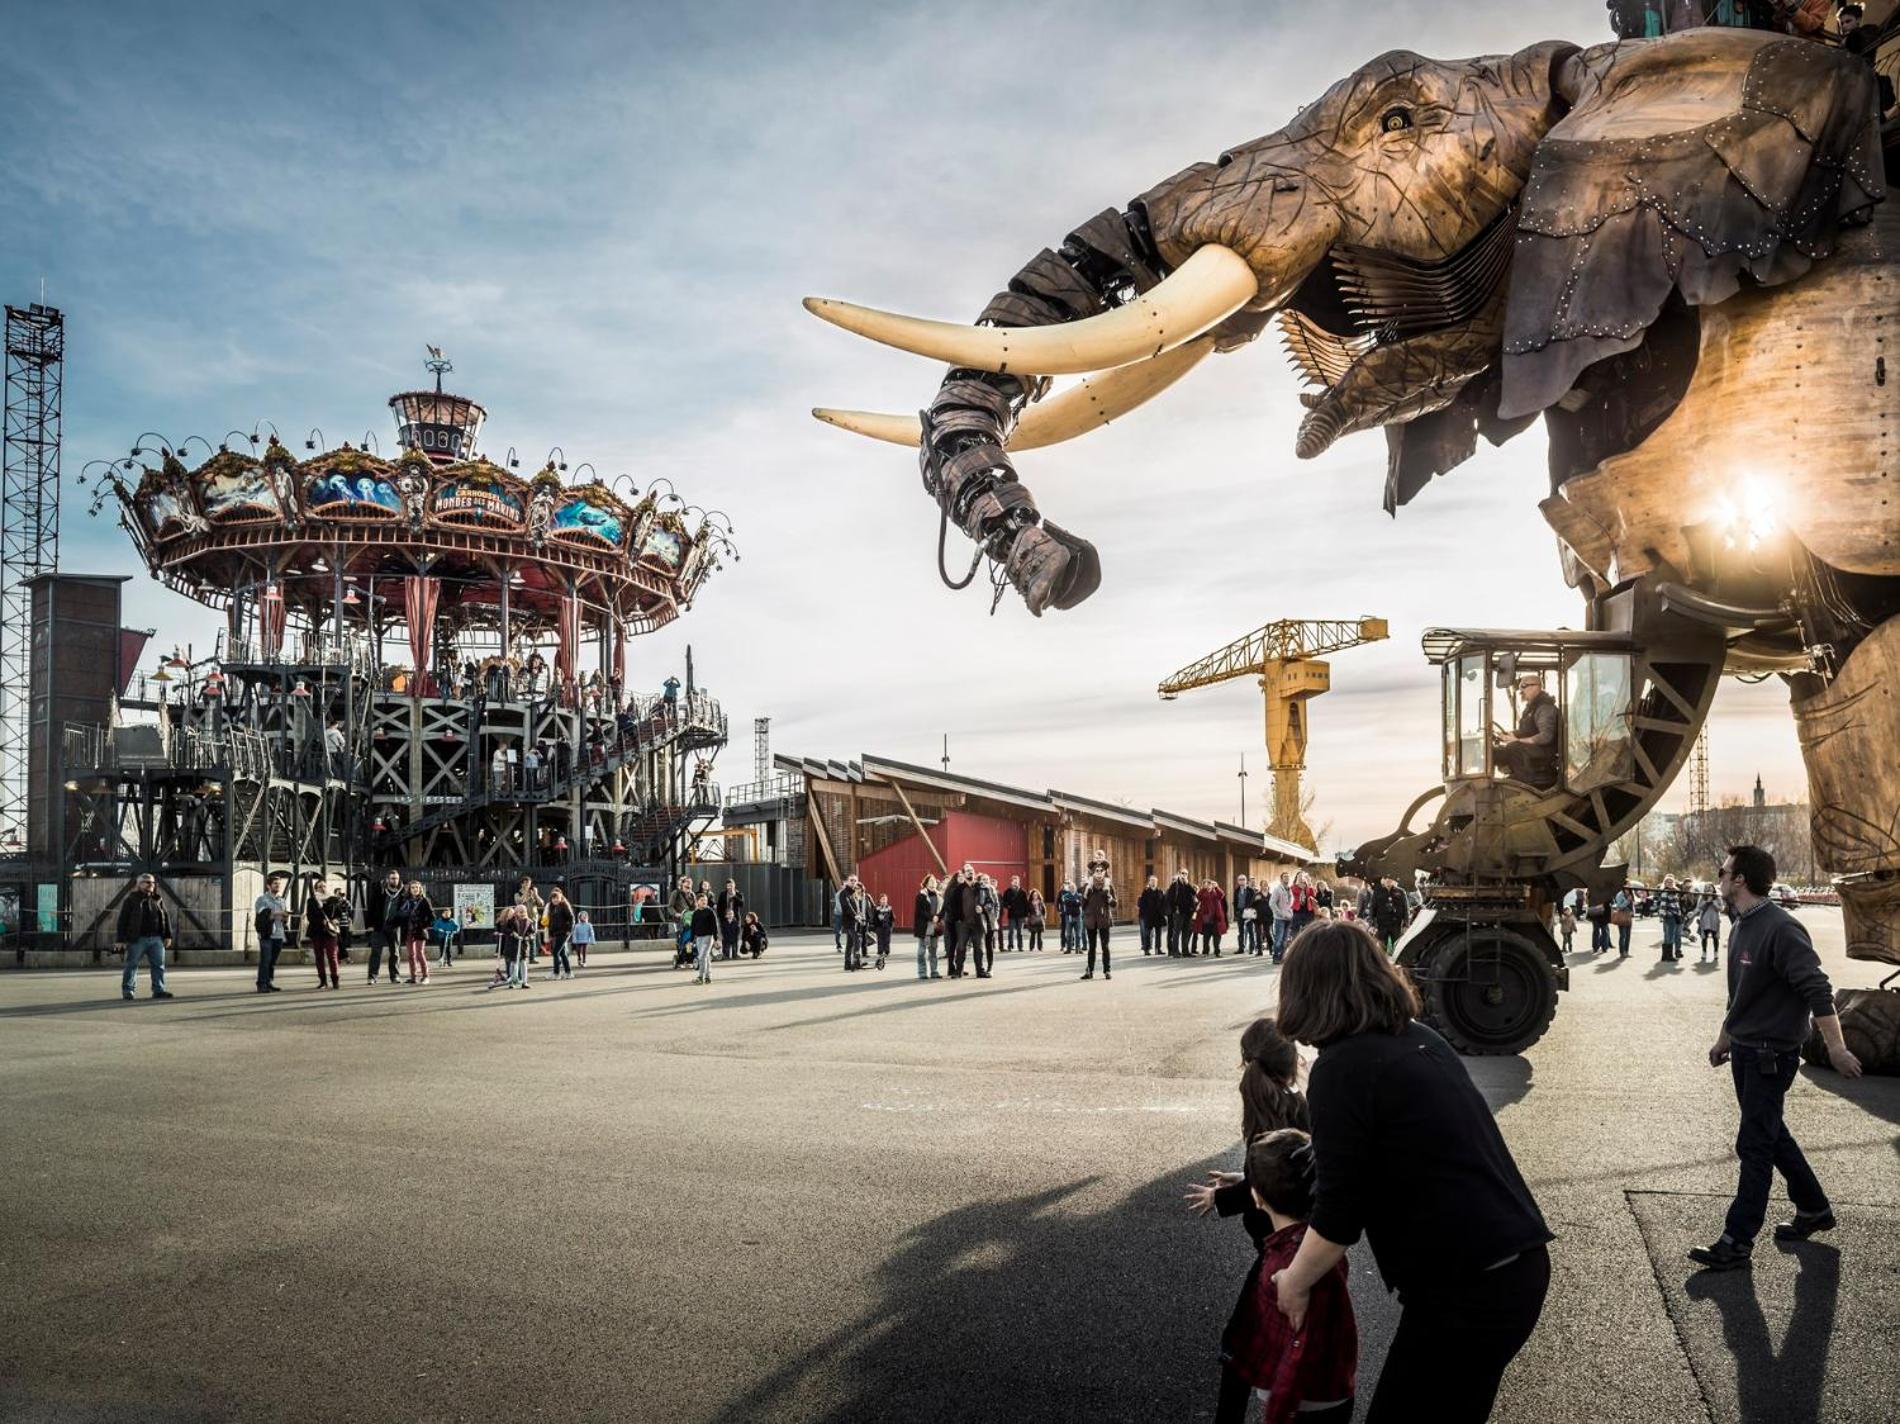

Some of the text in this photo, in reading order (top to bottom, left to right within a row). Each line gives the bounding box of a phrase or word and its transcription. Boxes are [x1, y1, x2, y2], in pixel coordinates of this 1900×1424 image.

[456, 489, 501, 502] CARROUSEL
[436, 497, 472, 512] MONDES
[487, 500, 520, 522] MARINS
